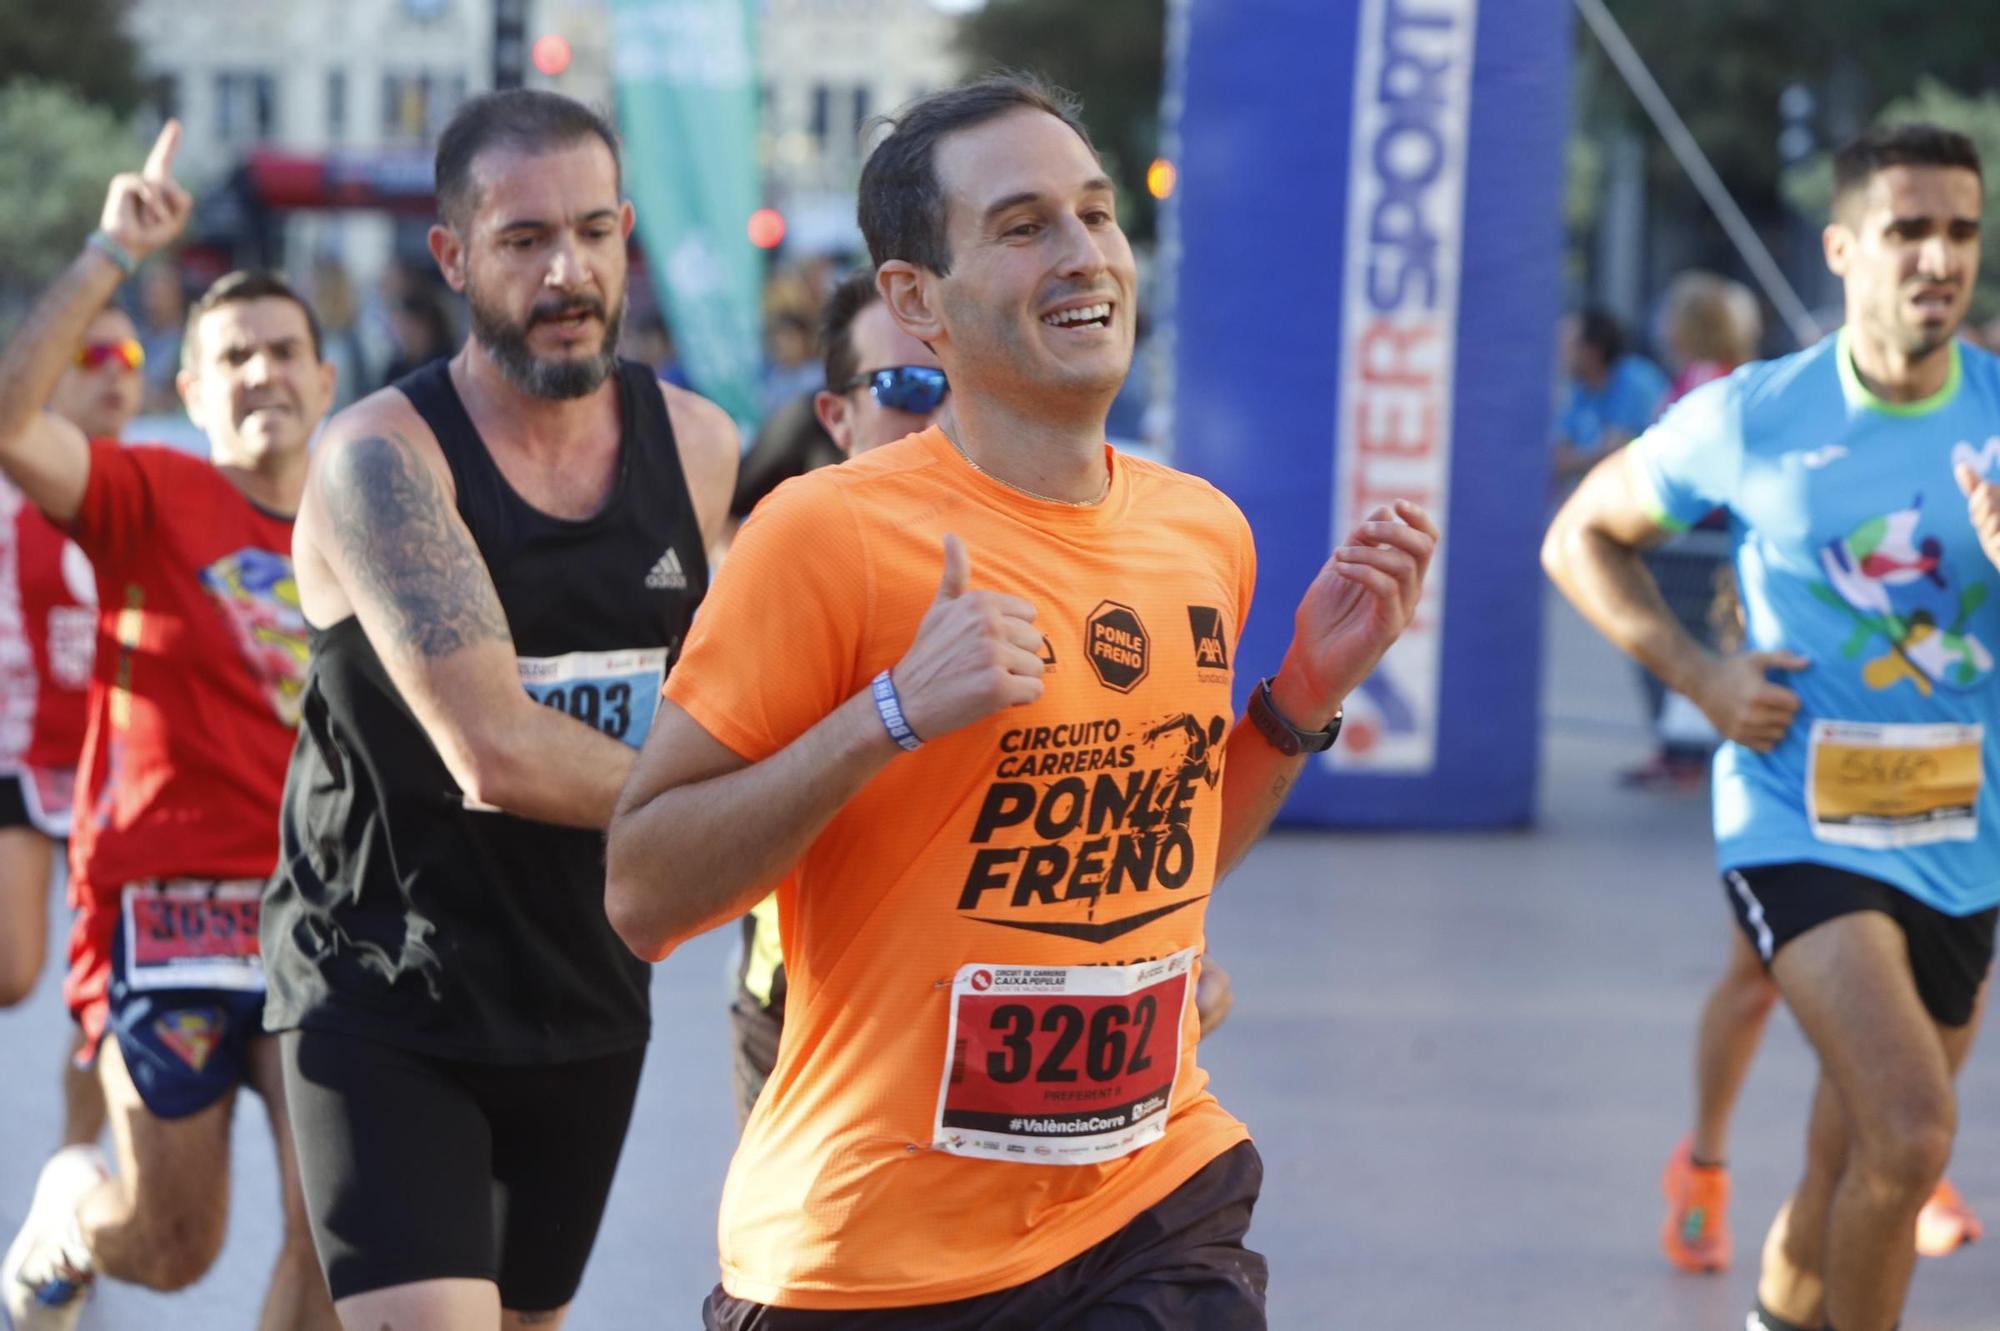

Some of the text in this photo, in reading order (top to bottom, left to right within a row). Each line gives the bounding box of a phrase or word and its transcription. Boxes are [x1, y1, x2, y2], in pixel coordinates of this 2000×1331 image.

[1350, 0, 1457, 630] TERSPORT
[644, 573, 687, 589] adidas
[1095, 623, 1142, 653] PONLE
[1196, 637, 1225, 664] AXA
[1094, 641, 1142, 669] FRENO
[524, 681, 631, 738] 93
[1000, 719, 1121, 753] CIRCUITO
[996, 745, 1135, 778] CARRERAS
[969, 770, 1198, 843] PONLE
[956, 823, 1194, 910] FRENO
[994, 977, 1065, 985] CAIXA POPULAR
[986, 994, 1157, 1084] 3262
[1044, 1088, 1113, 1100] PREFERENT
[1009, 1115, 1126, 1133] #ValènciaCorre
